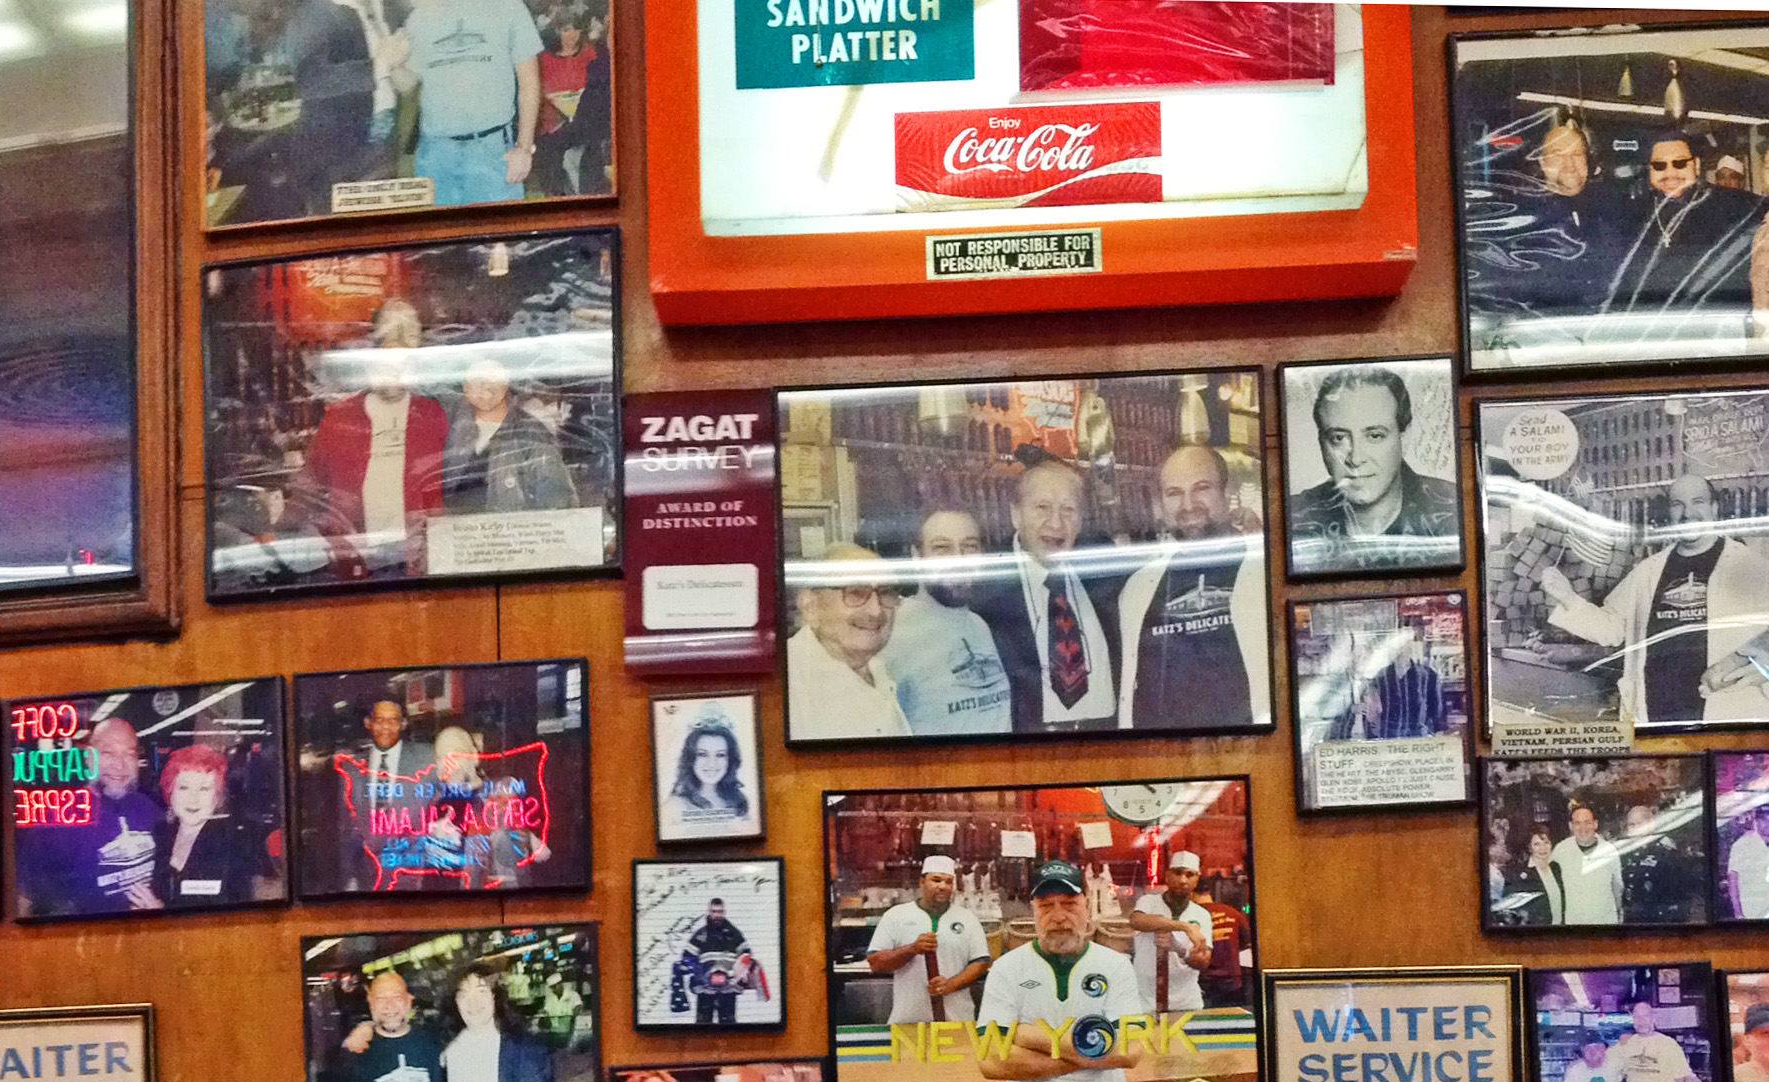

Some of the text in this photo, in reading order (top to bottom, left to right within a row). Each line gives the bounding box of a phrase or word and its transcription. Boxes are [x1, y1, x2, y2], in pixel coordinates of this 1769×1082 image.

[766, 0, 940, 28] SANDWICH
[791, 30, 918, 64] PLATTER
[988, 116, 1021, 131] Enjoy
[943, 123, 1101, 175] Coca-Cola
[935, 234, 1091, 257] NOT RESPONSIBLE FOR
[939, 251, 1087, 273] PERSONAL PROPERTY
[1519, 414, 1549, 426] Send
[640, 414, 759, 443] ZAGAT
[1510, 425, 1565, 437] A SALAMI
[1510, 443, 1570, 454] YOUR BOY
[641, 444, 762, 472] SURVEY
[1512, 455, 1570, 466] IN THE ARMY
[656, 500, 744, 514] AWARD OF
[642, 515, 759, 530] DISTINCTION
[1151, 621, 1184, 637] KATZ'S
[947, 697, 978, 715] KATZ'S
[1505, 726, 1621, 736] WORLD WAR II, KOREA,
[1501, 735, 1625, 746] VIETNAM, PERSIAN GULF
[1319, 742, 1446, 758] ED HARRIS THE RIGHT
[1531, 747, 1563, 755] FEEDS
[1566, 746, 1586, 755] THE
[1591, 746, 1631, 754] TROOPS
[1138, 804, 1146, 815] 5
[1293, 1005, 1496, 1044] WAITER
[888, 1017, 1021, 1063] NEW
